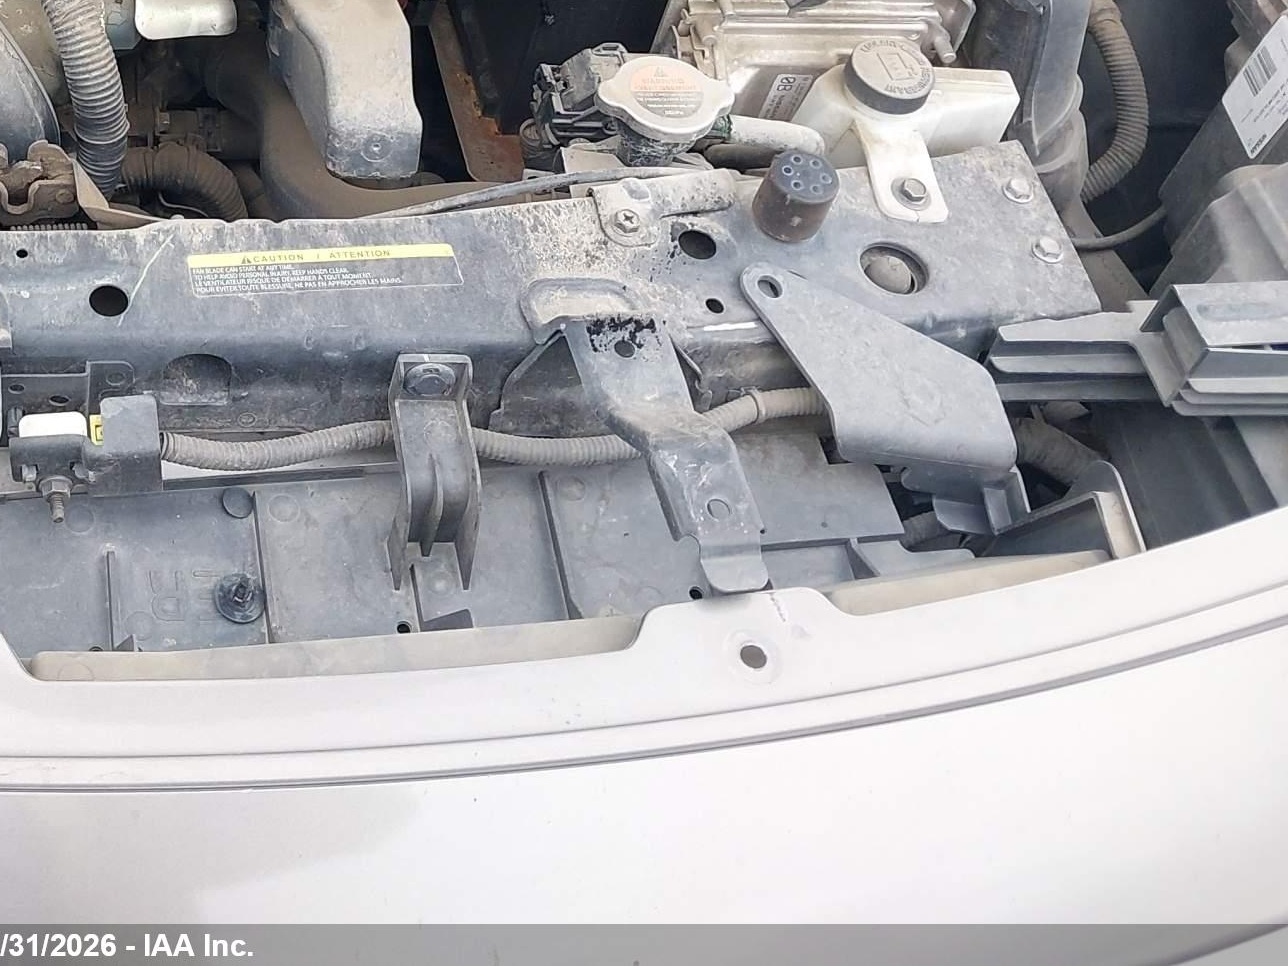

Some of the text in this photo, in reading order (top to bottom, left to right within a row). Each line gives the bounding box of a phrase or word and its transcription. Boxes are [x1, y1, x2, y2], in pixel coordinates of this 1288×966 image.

[252, 253, 305, 264] CAUTION
[329, 248, 391, 259] ATTENTION
[225, 266, 239, 274] CAN
[238, 271, 269, 279] PERSONAL
[196, 286, 215, 294] POUR
[328, 278, 368, 287] APPROCHER
[203, 278, 246, 287] VENTILATEUR
[246, 277, 267, 285] RISQUE
[324, 273, 341, 281] TOUT
